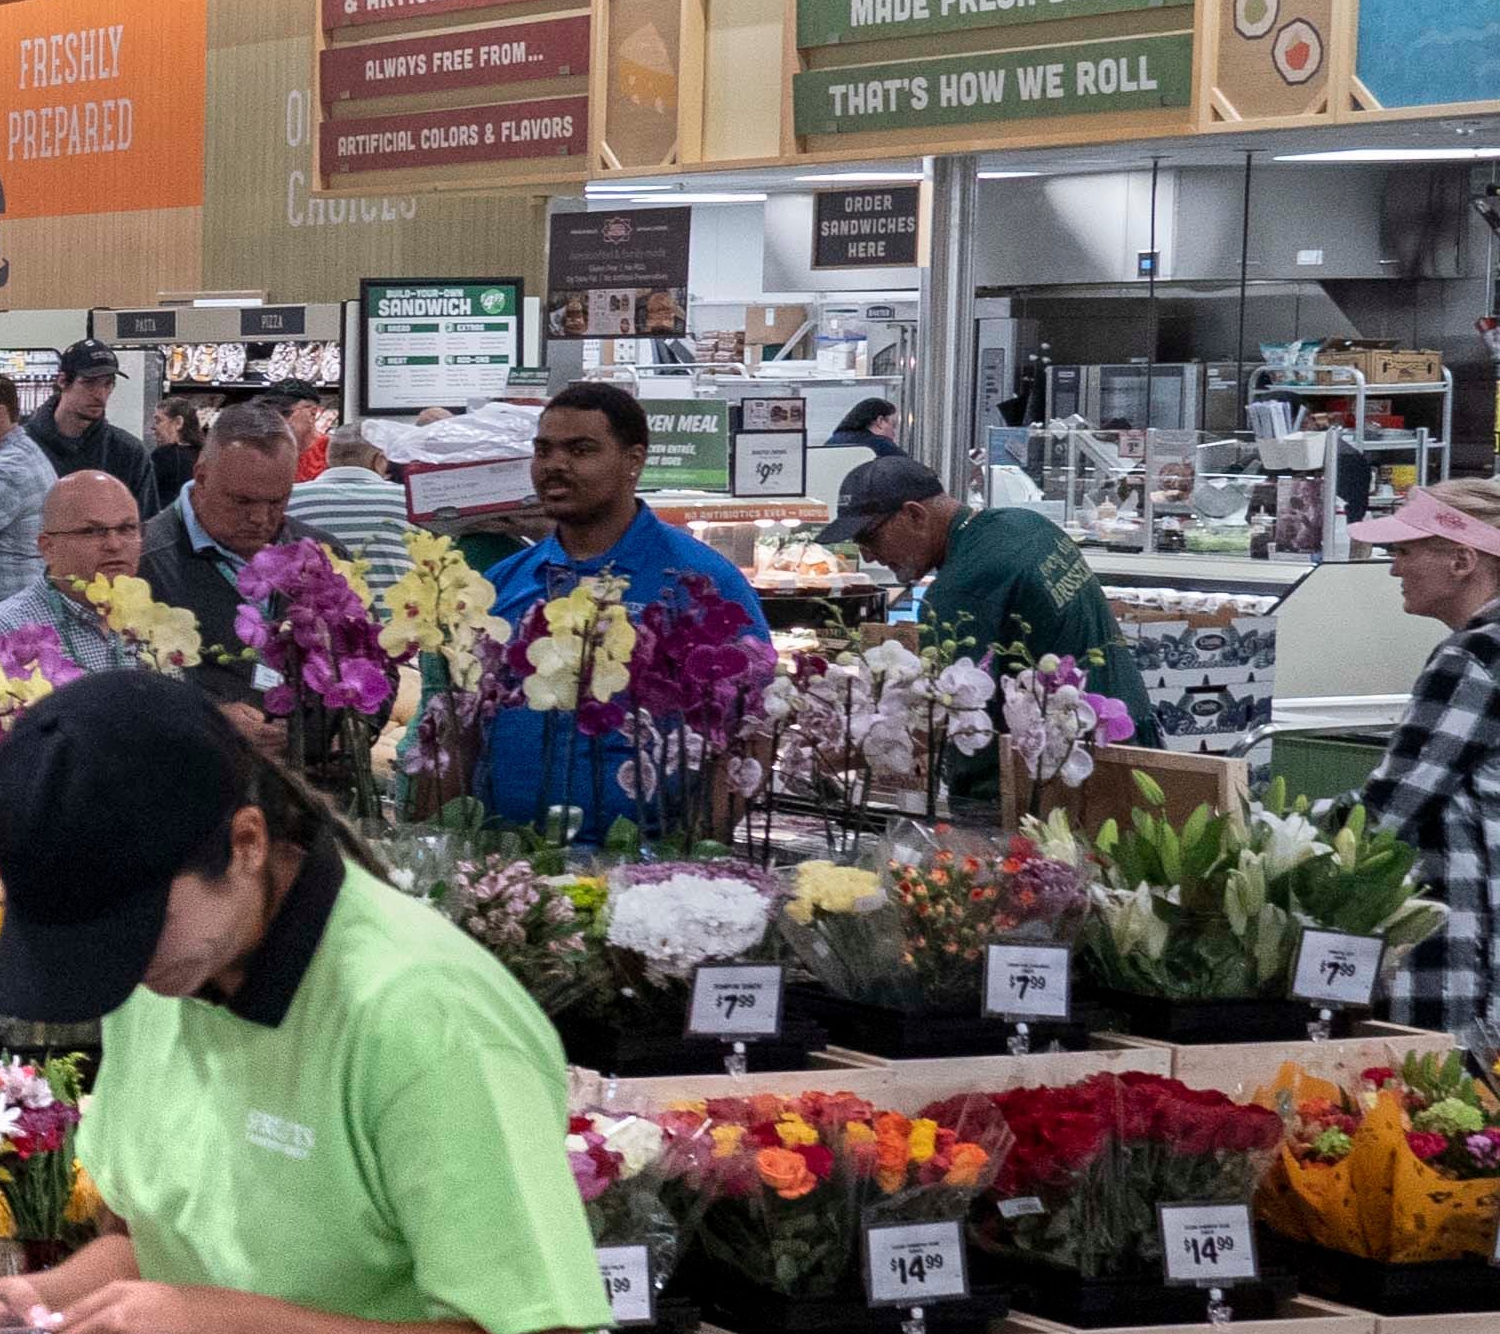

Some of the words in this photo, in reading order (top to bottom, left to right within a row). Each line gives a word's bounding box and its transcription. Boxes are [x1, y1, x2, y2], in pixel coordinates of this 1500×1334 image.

[18, 23, 125, 90] FRESHLY
[365, 53, 427, 81] ALWAYS
[433, 47, 474, 73] FREE
[479, 41, 544, 67] FROM...
[828, 76, 929, 117] THAT'S
[939, 68, 1005, 107] HOW
[1016, 64, 1065, 100] WE
[1076, 55, 1159, 96] ROLL
[7, 97, 134, 163] PREPARED
[337, 130, 416, 156] ARTIFICIAL
[421, 123, 479, 149] COLORS
[484, 123, 496, 142] &
[501, 115, 573, 142] FLAVORS
[844, 195, 892, 213] ORDER
[821, 216, 916, 236] SANDWICHES
[848, 241, 886, 259] HERE
[385, 288, 465, 300] BUILD-YOUR-OWN
[378, 298, 472, 317] SANDWICH
[134, 318, 159, 334] PASTA
[260, 314, 284, 331] PIZZA
[677, 415, 719, 434] MEAL
